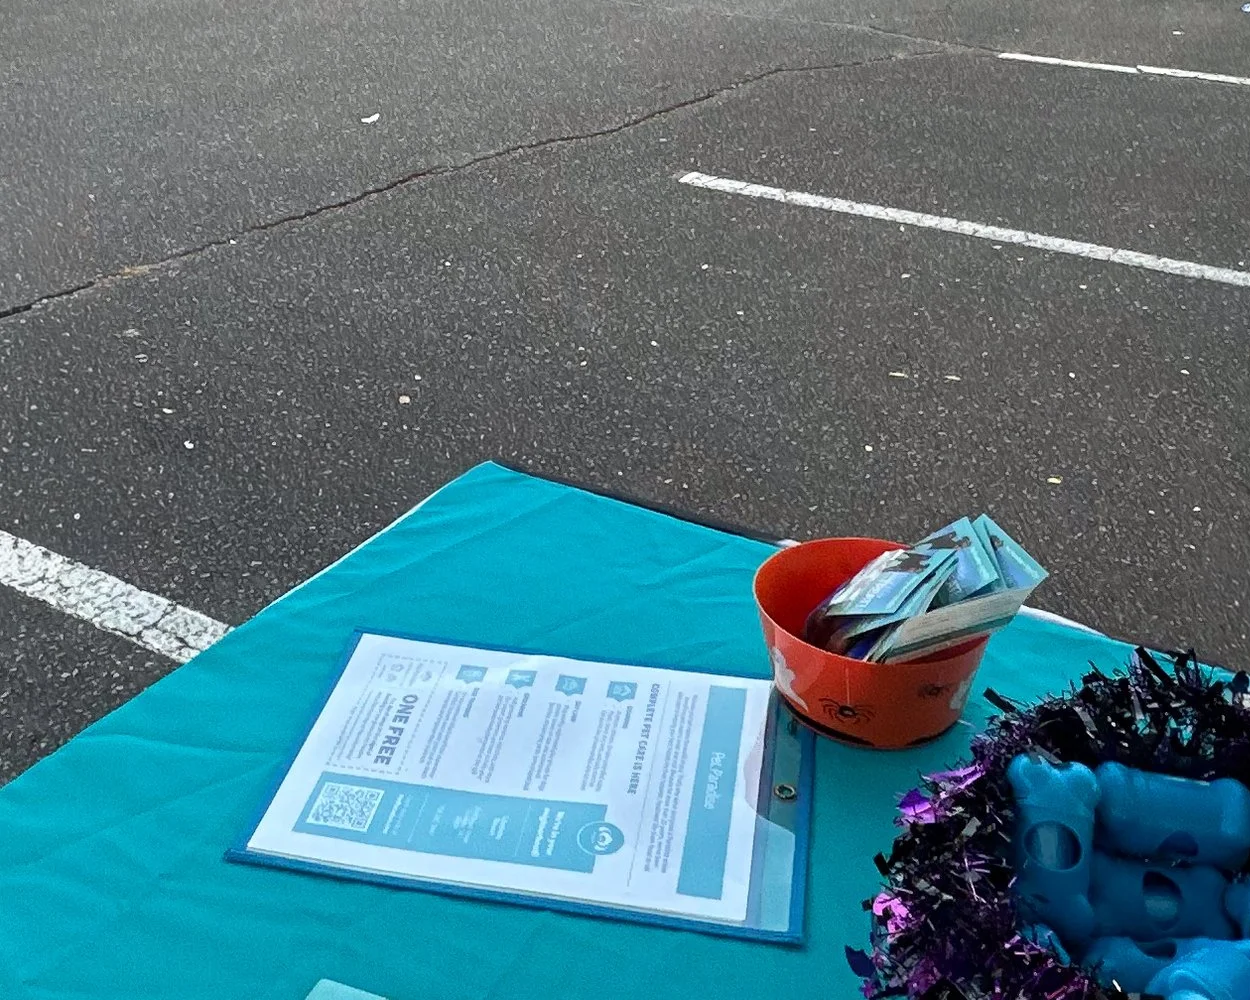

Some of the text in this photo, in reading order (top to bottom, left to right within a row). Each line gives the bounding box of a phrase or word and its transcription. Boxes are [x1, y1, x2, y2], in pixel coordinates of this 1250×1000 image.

[391, 693, 419, 724] ONE
[643, 683, 660, 721] COMPLETE
[372, 725, 406, 766] FREE
[640, 723, 651, 739] PET
[635, 740, 647, 761] CARE
[627, 772, 640, 795] HERE
[703, 751, 726, 811] Pet Paradise
